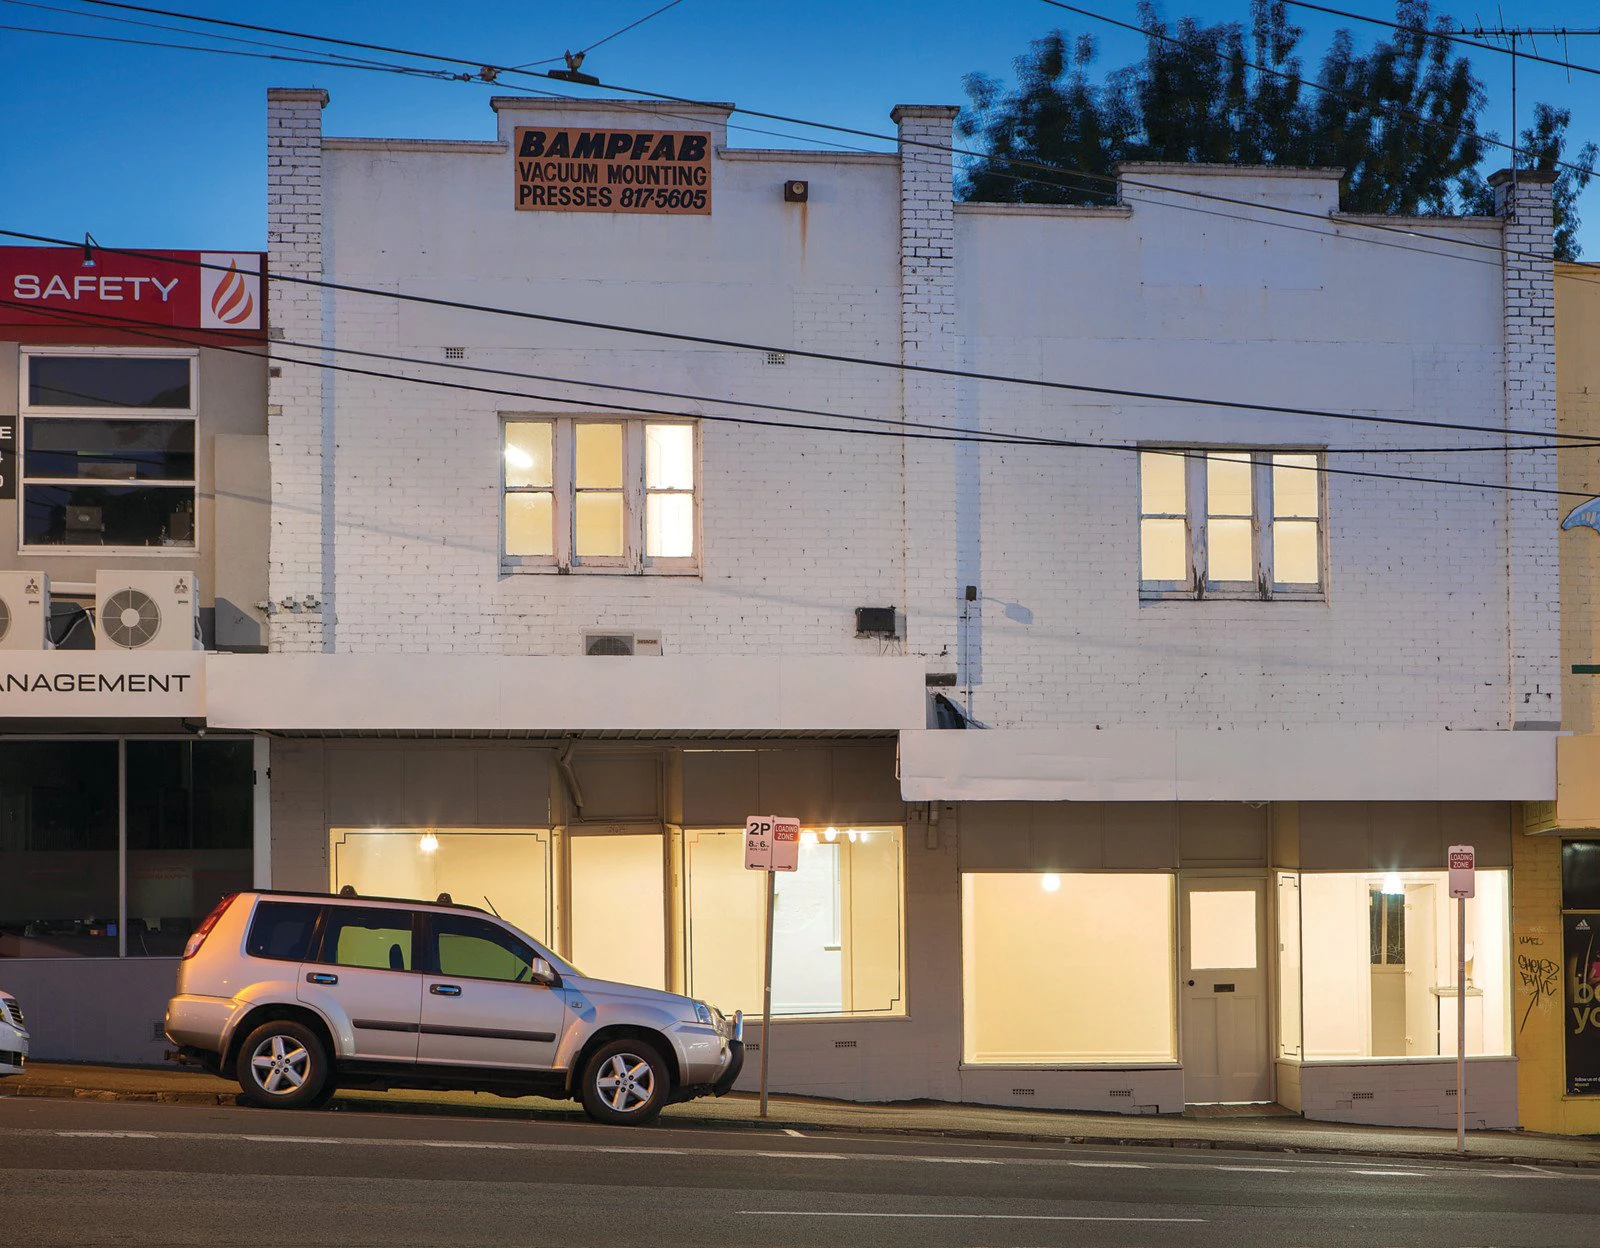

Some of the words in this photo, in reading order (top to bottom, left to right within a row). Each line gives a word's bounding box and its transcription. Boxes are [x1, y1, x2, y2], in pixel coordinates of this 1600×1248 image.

[518, 130, 708, 162] BAMPFAB
[518, 161, 599, 184] VACUUM
[607, 164, 708, 187] MOUNTING
[518, 184, 613, 208] PRESSES
[13, 274, 179, 302] SAFETY
[0, 673, 191, 693] NAGEMENT
[749, 822, 771, 836] 2P
[775, 825, 798, 833] LOADING
[777, 833, 794, 841] ZONE
[1450, 853, 1473, 861] LOADING
